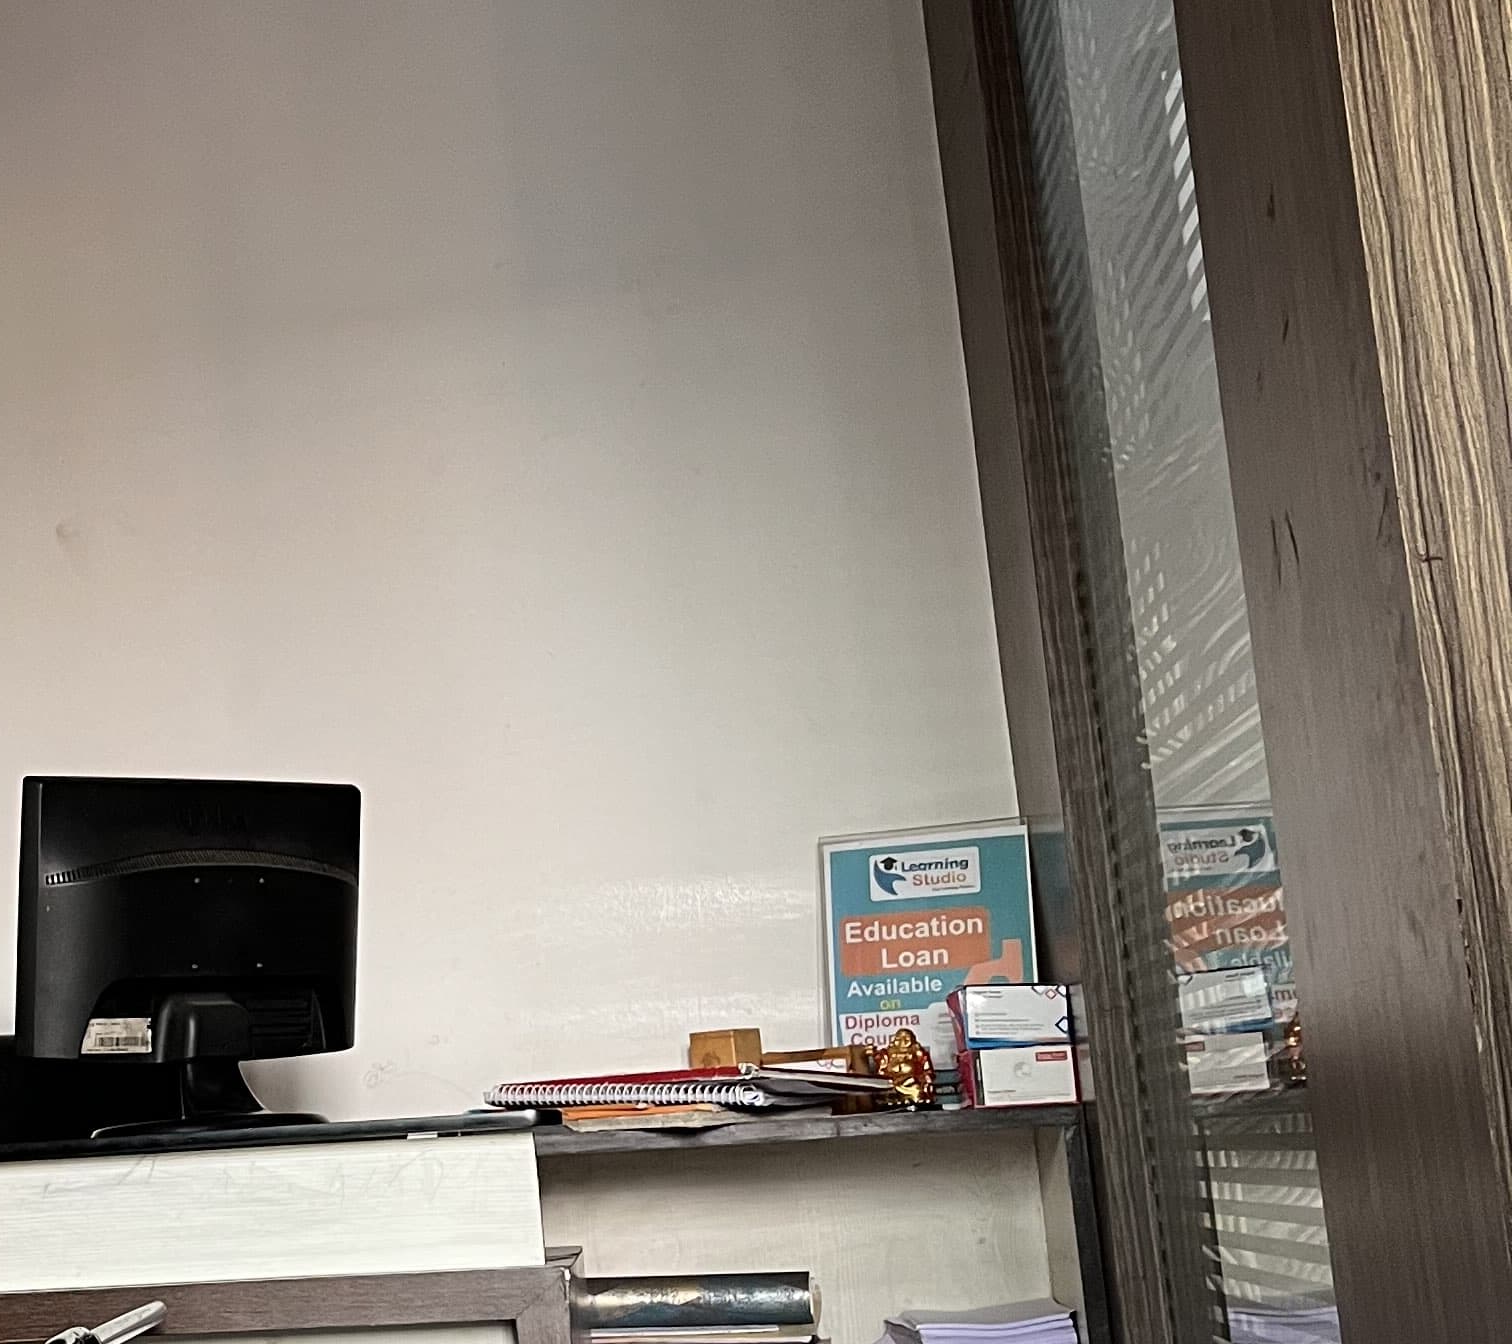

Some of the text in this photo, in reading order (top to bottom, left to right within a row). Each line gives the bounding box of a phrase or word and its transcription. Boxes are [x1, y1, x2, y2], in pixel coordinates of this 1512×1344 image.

[901, 858, 969, 873] Learning
[912, 870, 968, 887] Studio
[844, 914, 984, 945] Education
[881, 947, 950, 970] Loan
[847, 975, 943, 998] Available
[879, 998, 902, 1011] on
[844, 1013, 921, 1032] Diploma
